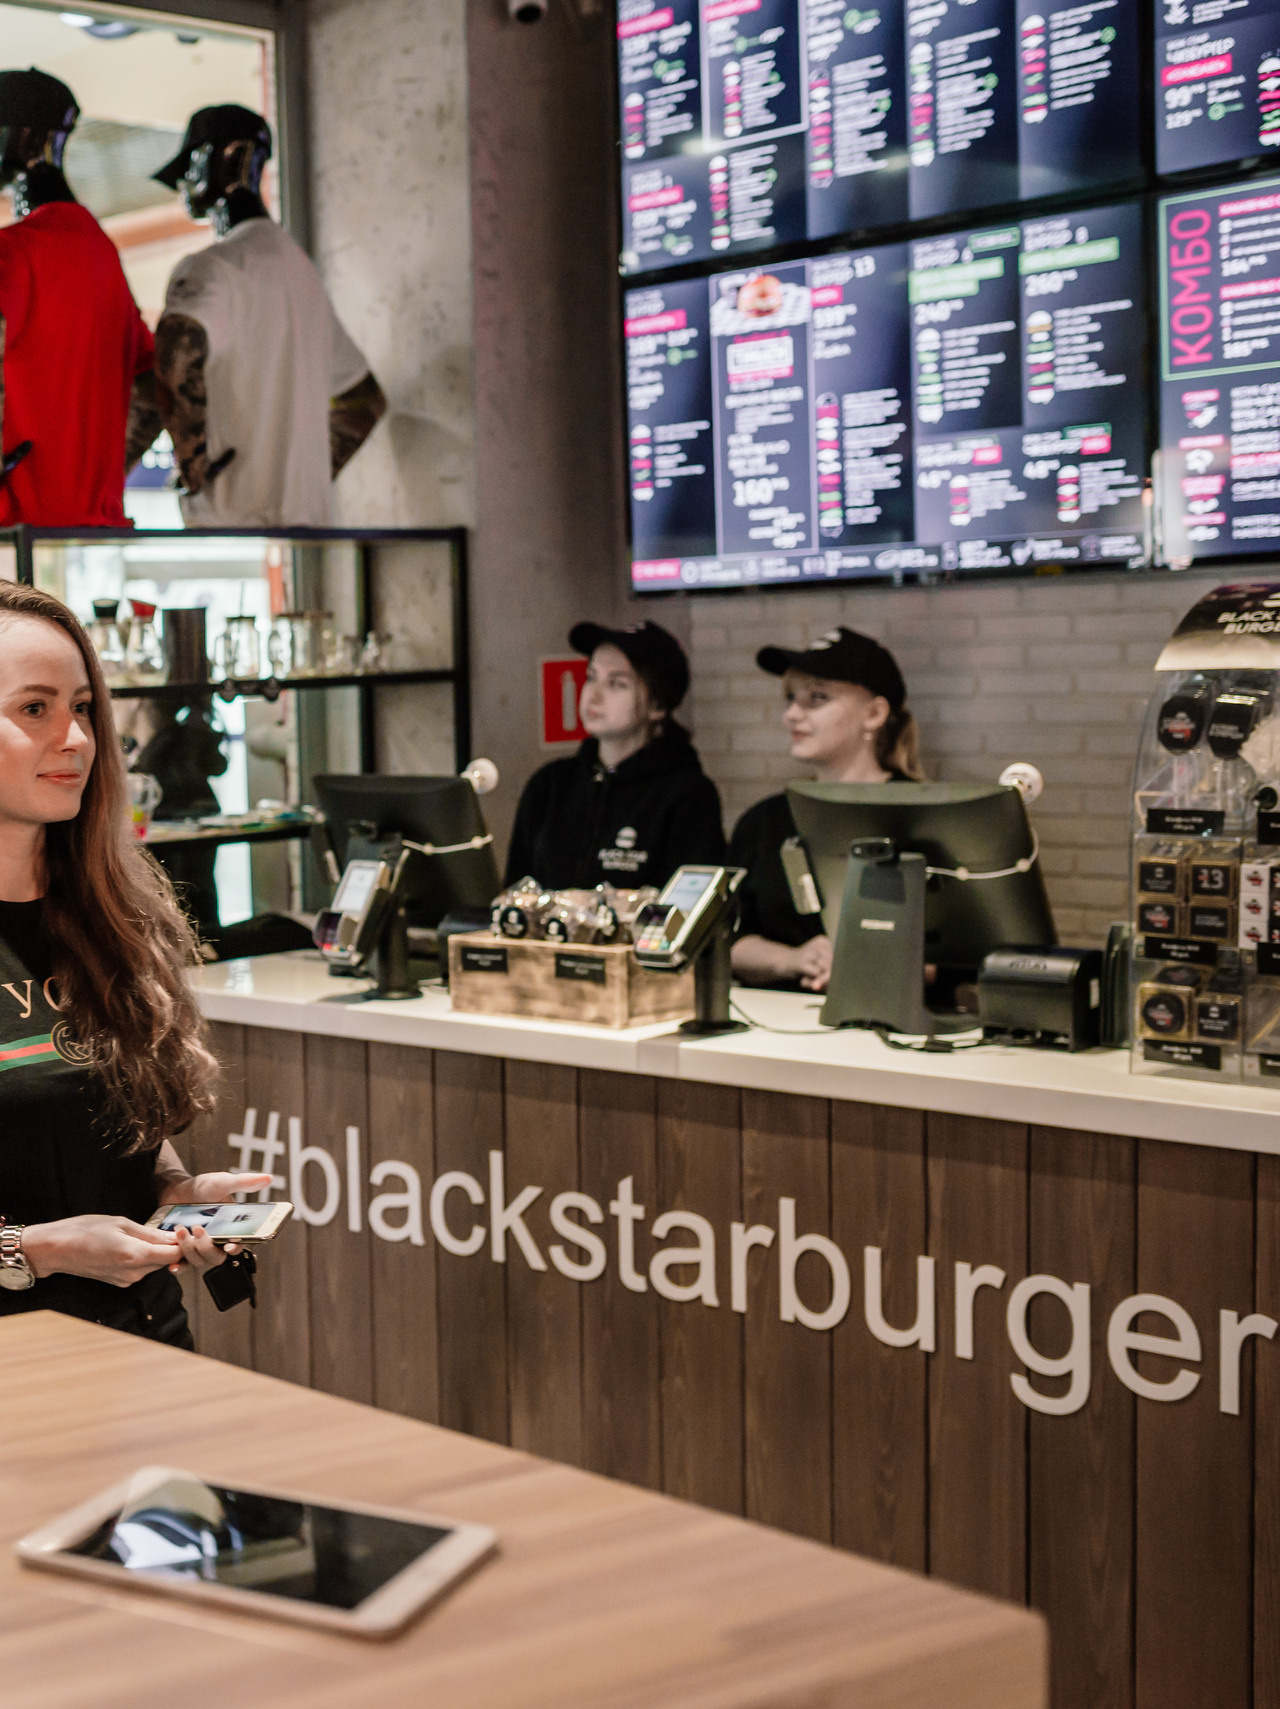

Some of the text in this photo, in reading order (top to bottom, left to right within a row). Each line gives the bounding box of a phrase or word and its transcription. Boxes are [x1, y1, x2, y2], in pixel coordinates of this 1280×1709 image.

[1169, 208, 1214, 367] КОМБО
[1217, 611, 1276, 623] BLACK
[227, 1106, 1278, 1416] #blackstarburger
